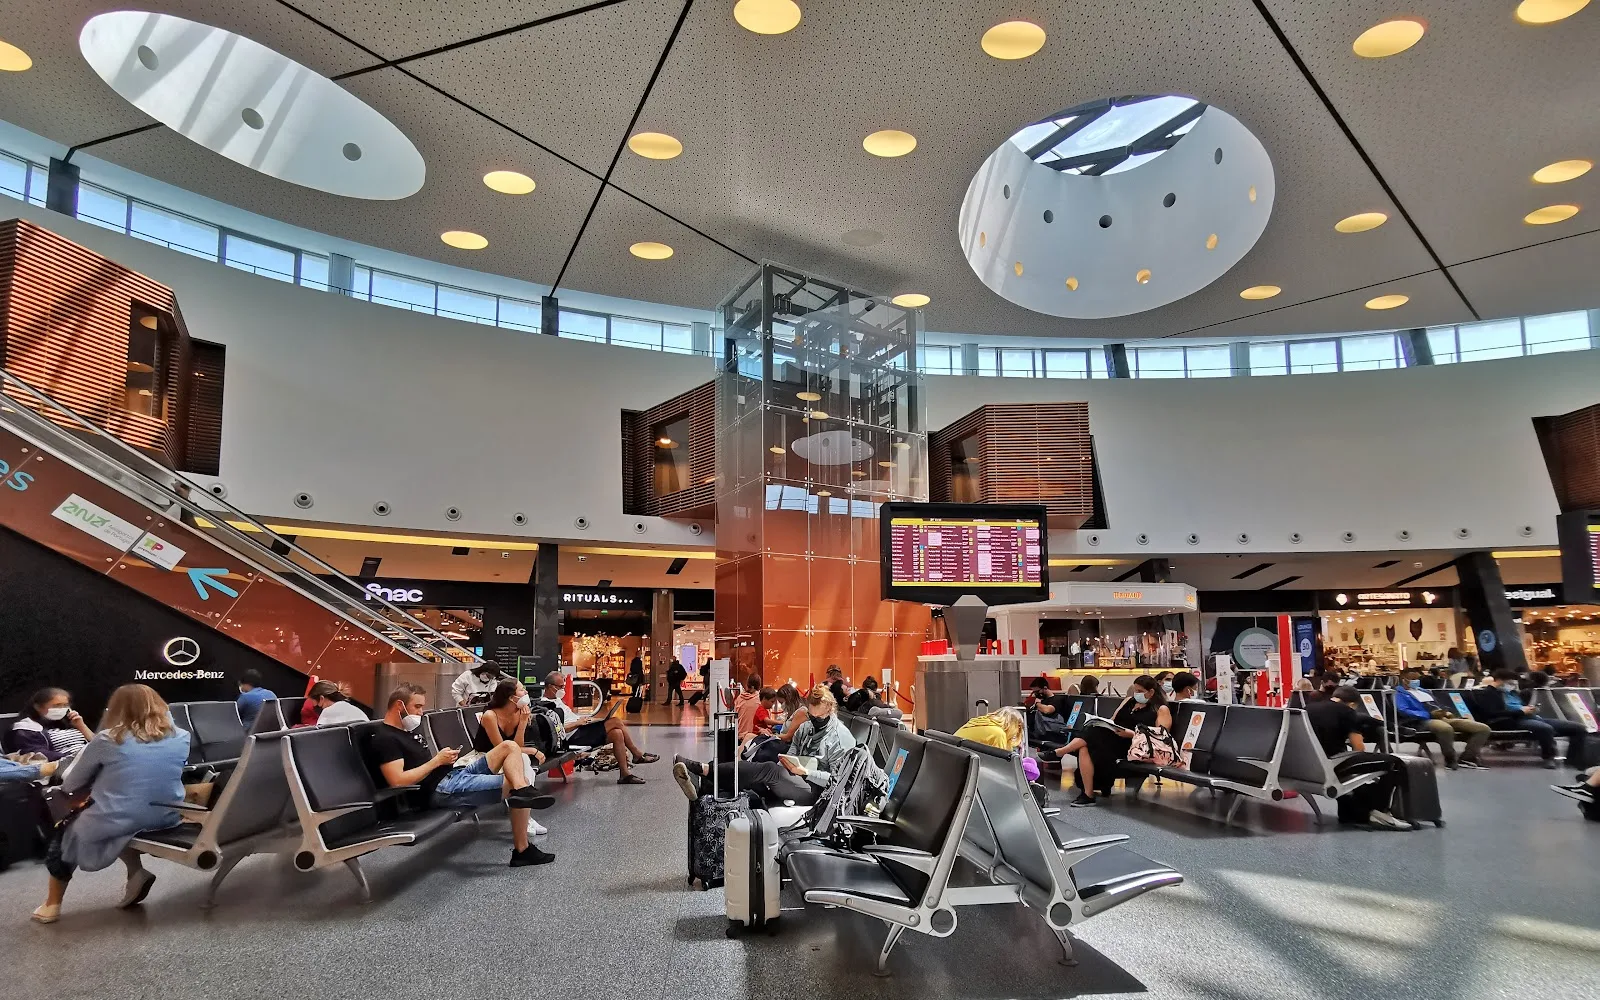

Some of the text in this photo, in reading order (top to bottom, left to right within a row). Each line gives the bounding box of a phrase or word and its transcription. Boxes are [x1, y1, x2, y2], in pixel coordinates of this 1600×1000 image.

[365, 583, 424, 602] fnac
[495, 625, 526, 635] fnac
[134, 670, 225, 680] Mercedes-Benz
